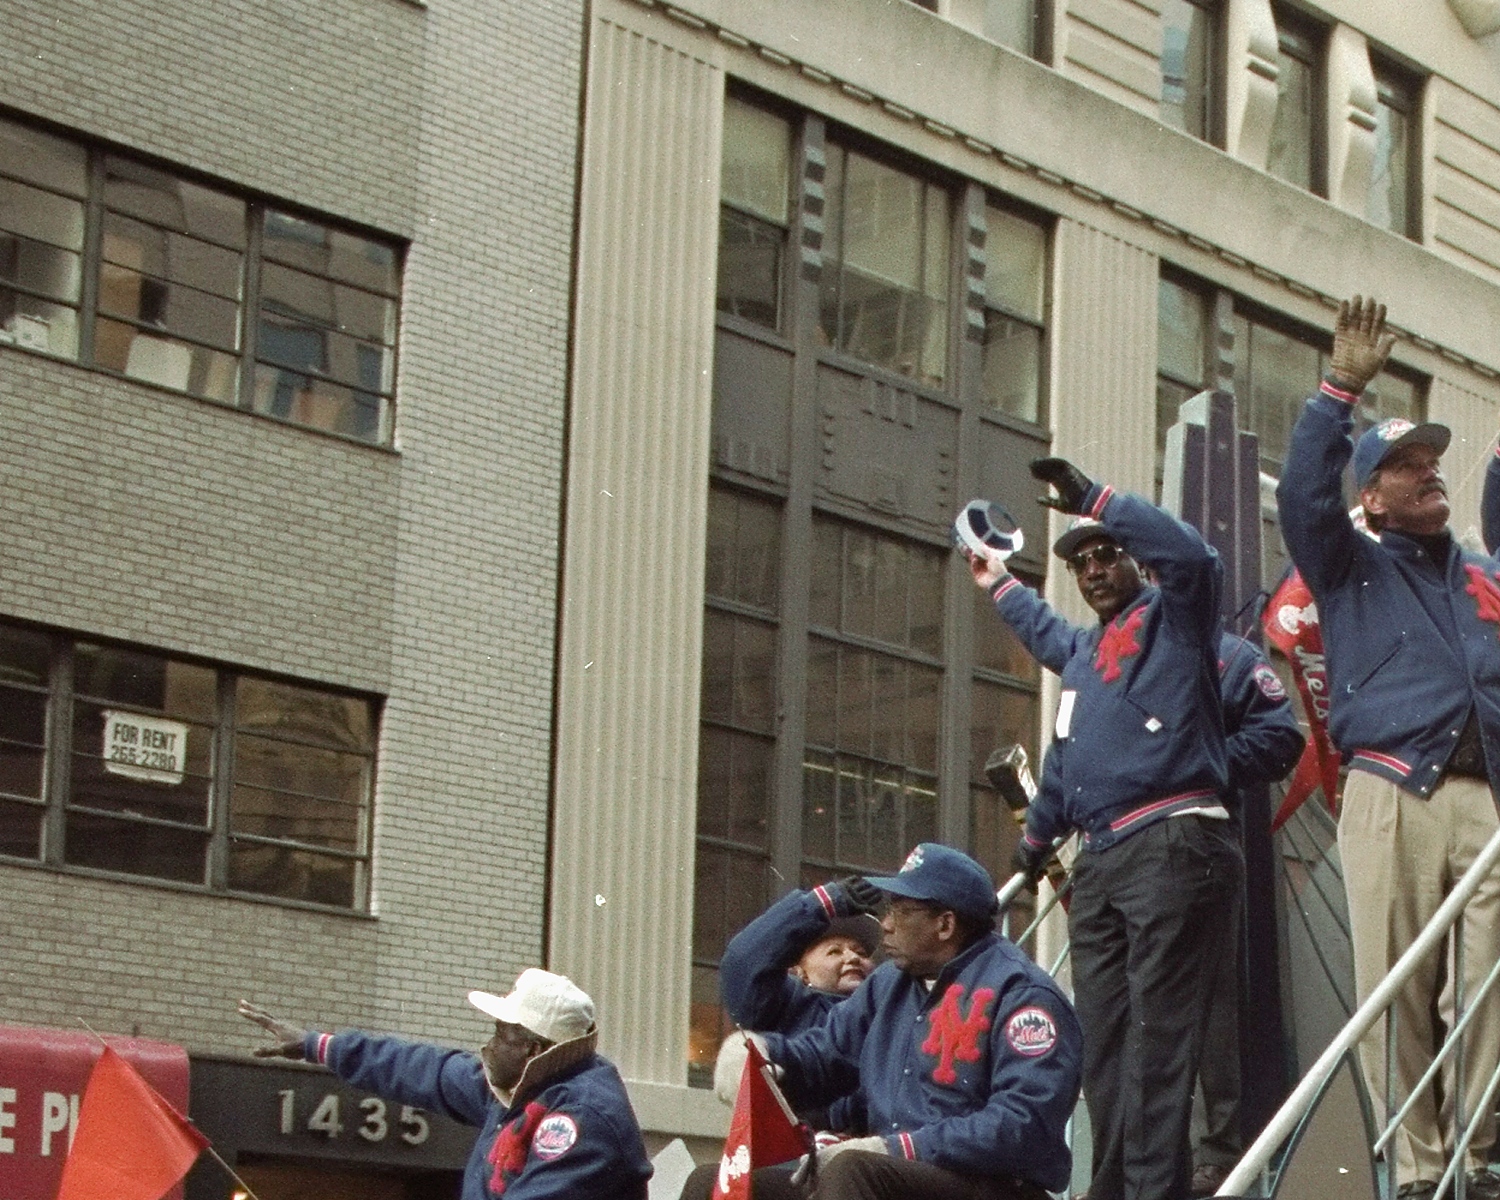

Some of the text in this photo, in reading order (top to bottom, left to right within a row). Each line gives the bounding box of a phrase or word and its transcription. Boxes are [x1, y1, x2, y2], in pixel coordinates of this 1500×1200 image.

[112, 722, 177, 752] FOR RENT
[277, 1088, 430, 1145] 1435
